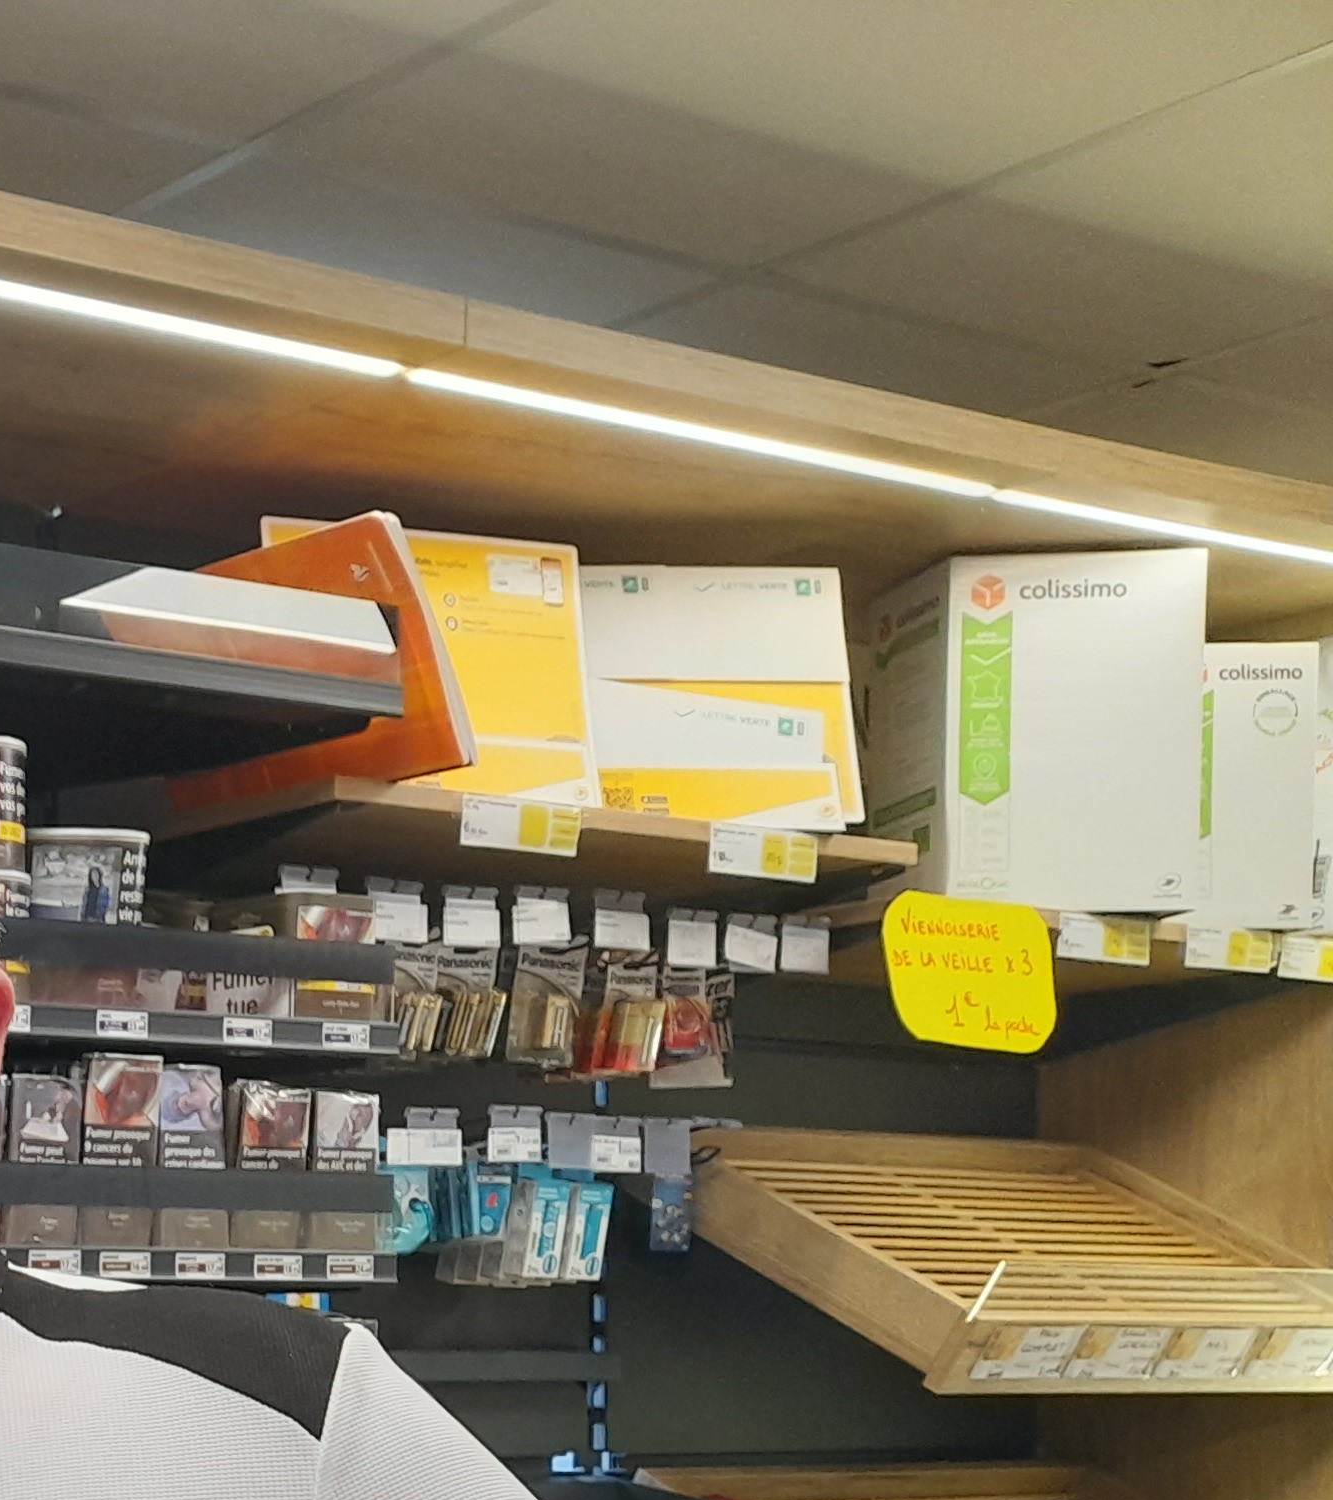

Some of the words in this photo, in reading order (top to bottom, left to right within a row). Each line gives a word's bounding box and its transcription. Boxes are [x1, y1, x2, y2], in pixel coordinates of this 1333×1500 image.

[758, 581, 788, 591] VERTE
[1018, 578, 1128, 601] colissimo
[1218, 663, 1303, 681] colissimo
[739, 715, 771, 727] VERTE
[437, 954, 493, 970] Panasonic
[521, 953, 581, 971] Panasonic
[892, 949, 913, 967] DE
[920, 951, 937, 967] LA
[941, 951, 994, 974] VEILLE
